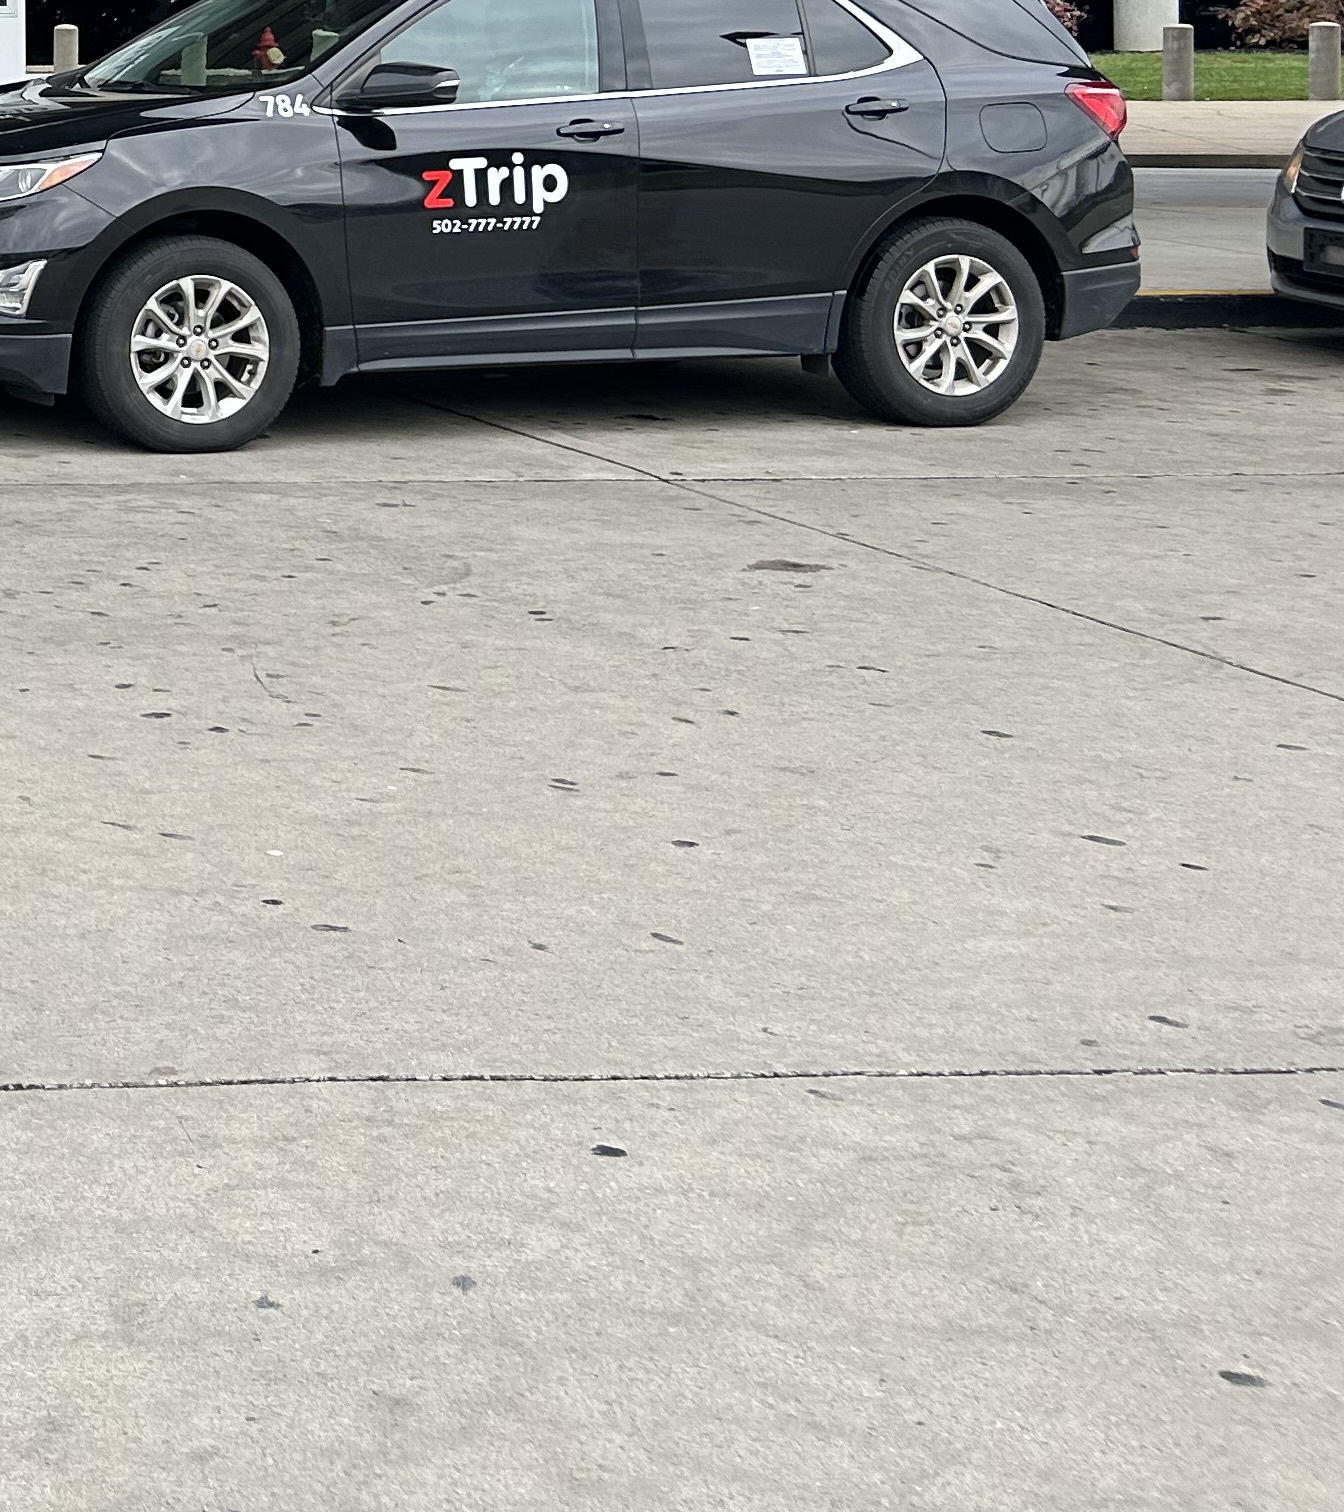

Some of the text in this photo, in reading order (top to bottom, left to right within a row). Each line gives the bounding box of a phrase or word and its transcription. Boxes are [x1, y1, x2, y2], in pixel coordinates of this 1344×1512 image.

[258, 93, 311, 118] 784
[422, 151, 569, 214] zTrip
[431, 216, 541, 234] 502-777-7777
